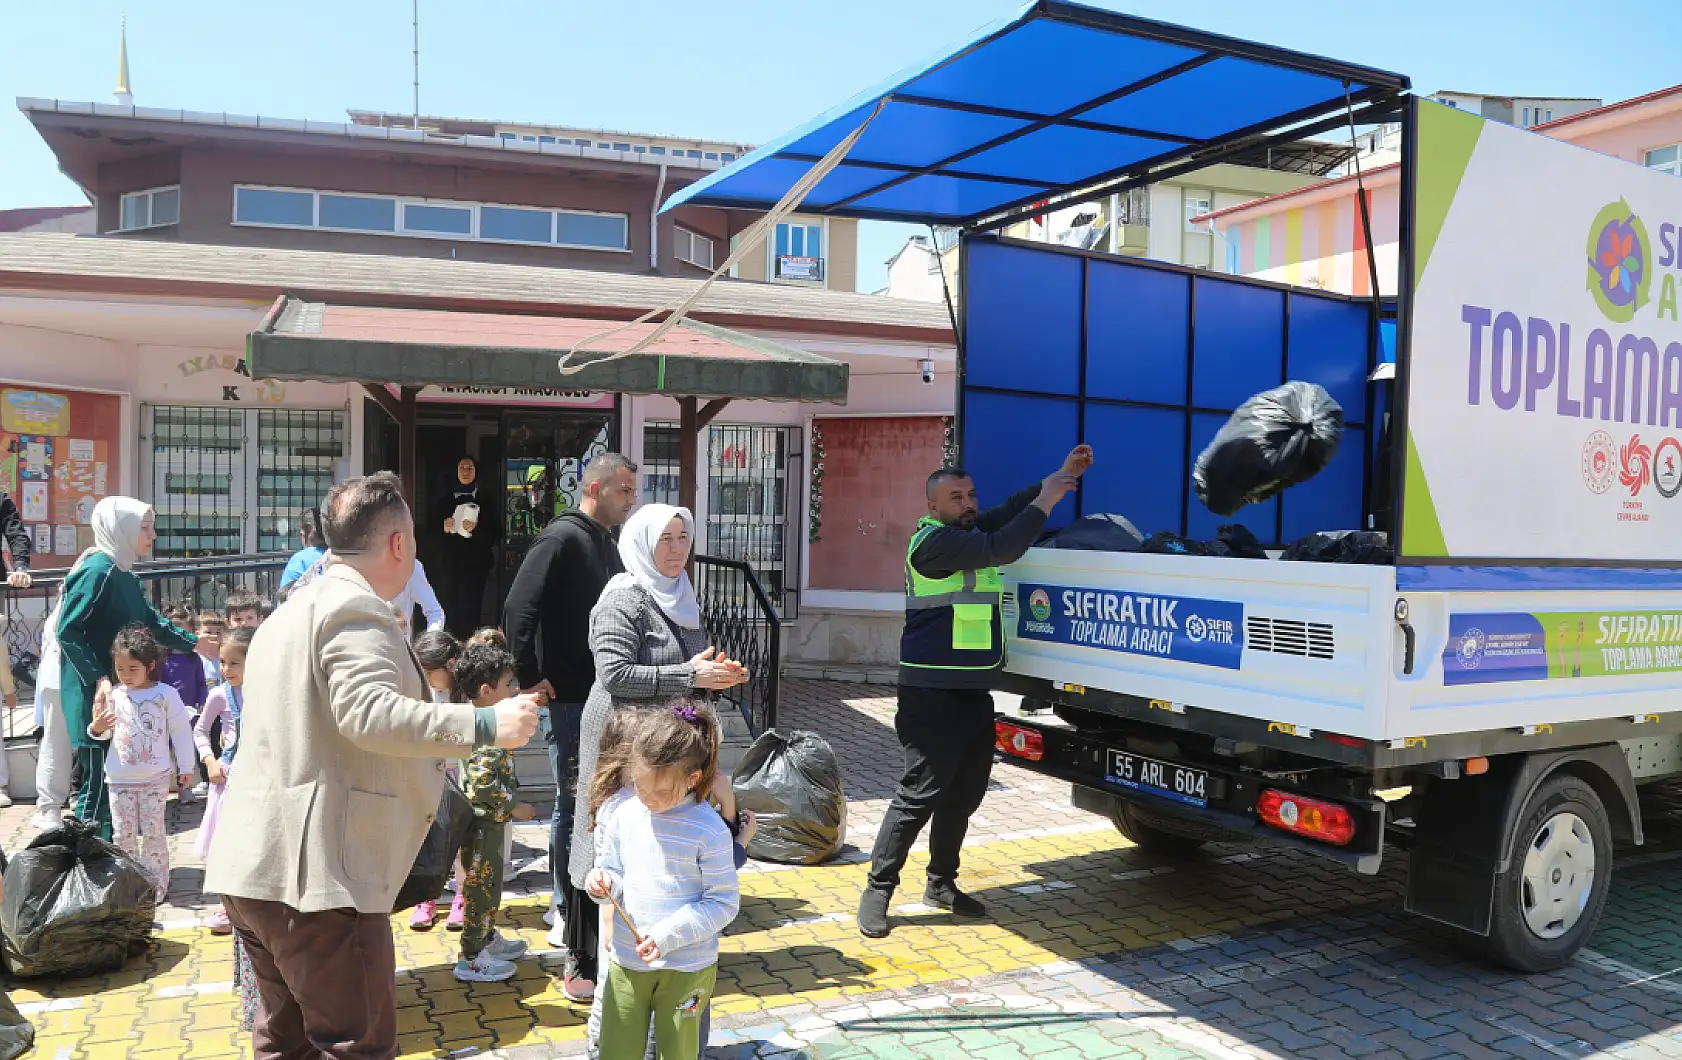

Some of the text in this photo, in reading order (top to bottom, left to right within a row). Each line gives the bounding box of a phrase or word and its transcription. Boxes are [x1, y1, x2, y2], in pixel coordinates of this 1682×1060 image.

[1462, 303, 1682, 429] TOPLAMA
[1070, 619, 1127, 648] TOPLAMA
[1130, 628, 1173, 654] ARACI
[1207, 617, 1233, 630] SIFIR
[1208, 630, 1233, 644] ATIK
[1600, 645, 1654, 671] TOPLAMA
[1115, 754, 1133, 779] 55
[1140, 761, 1168, 789] ARL
[1174, 768, 1205, 797] 604
